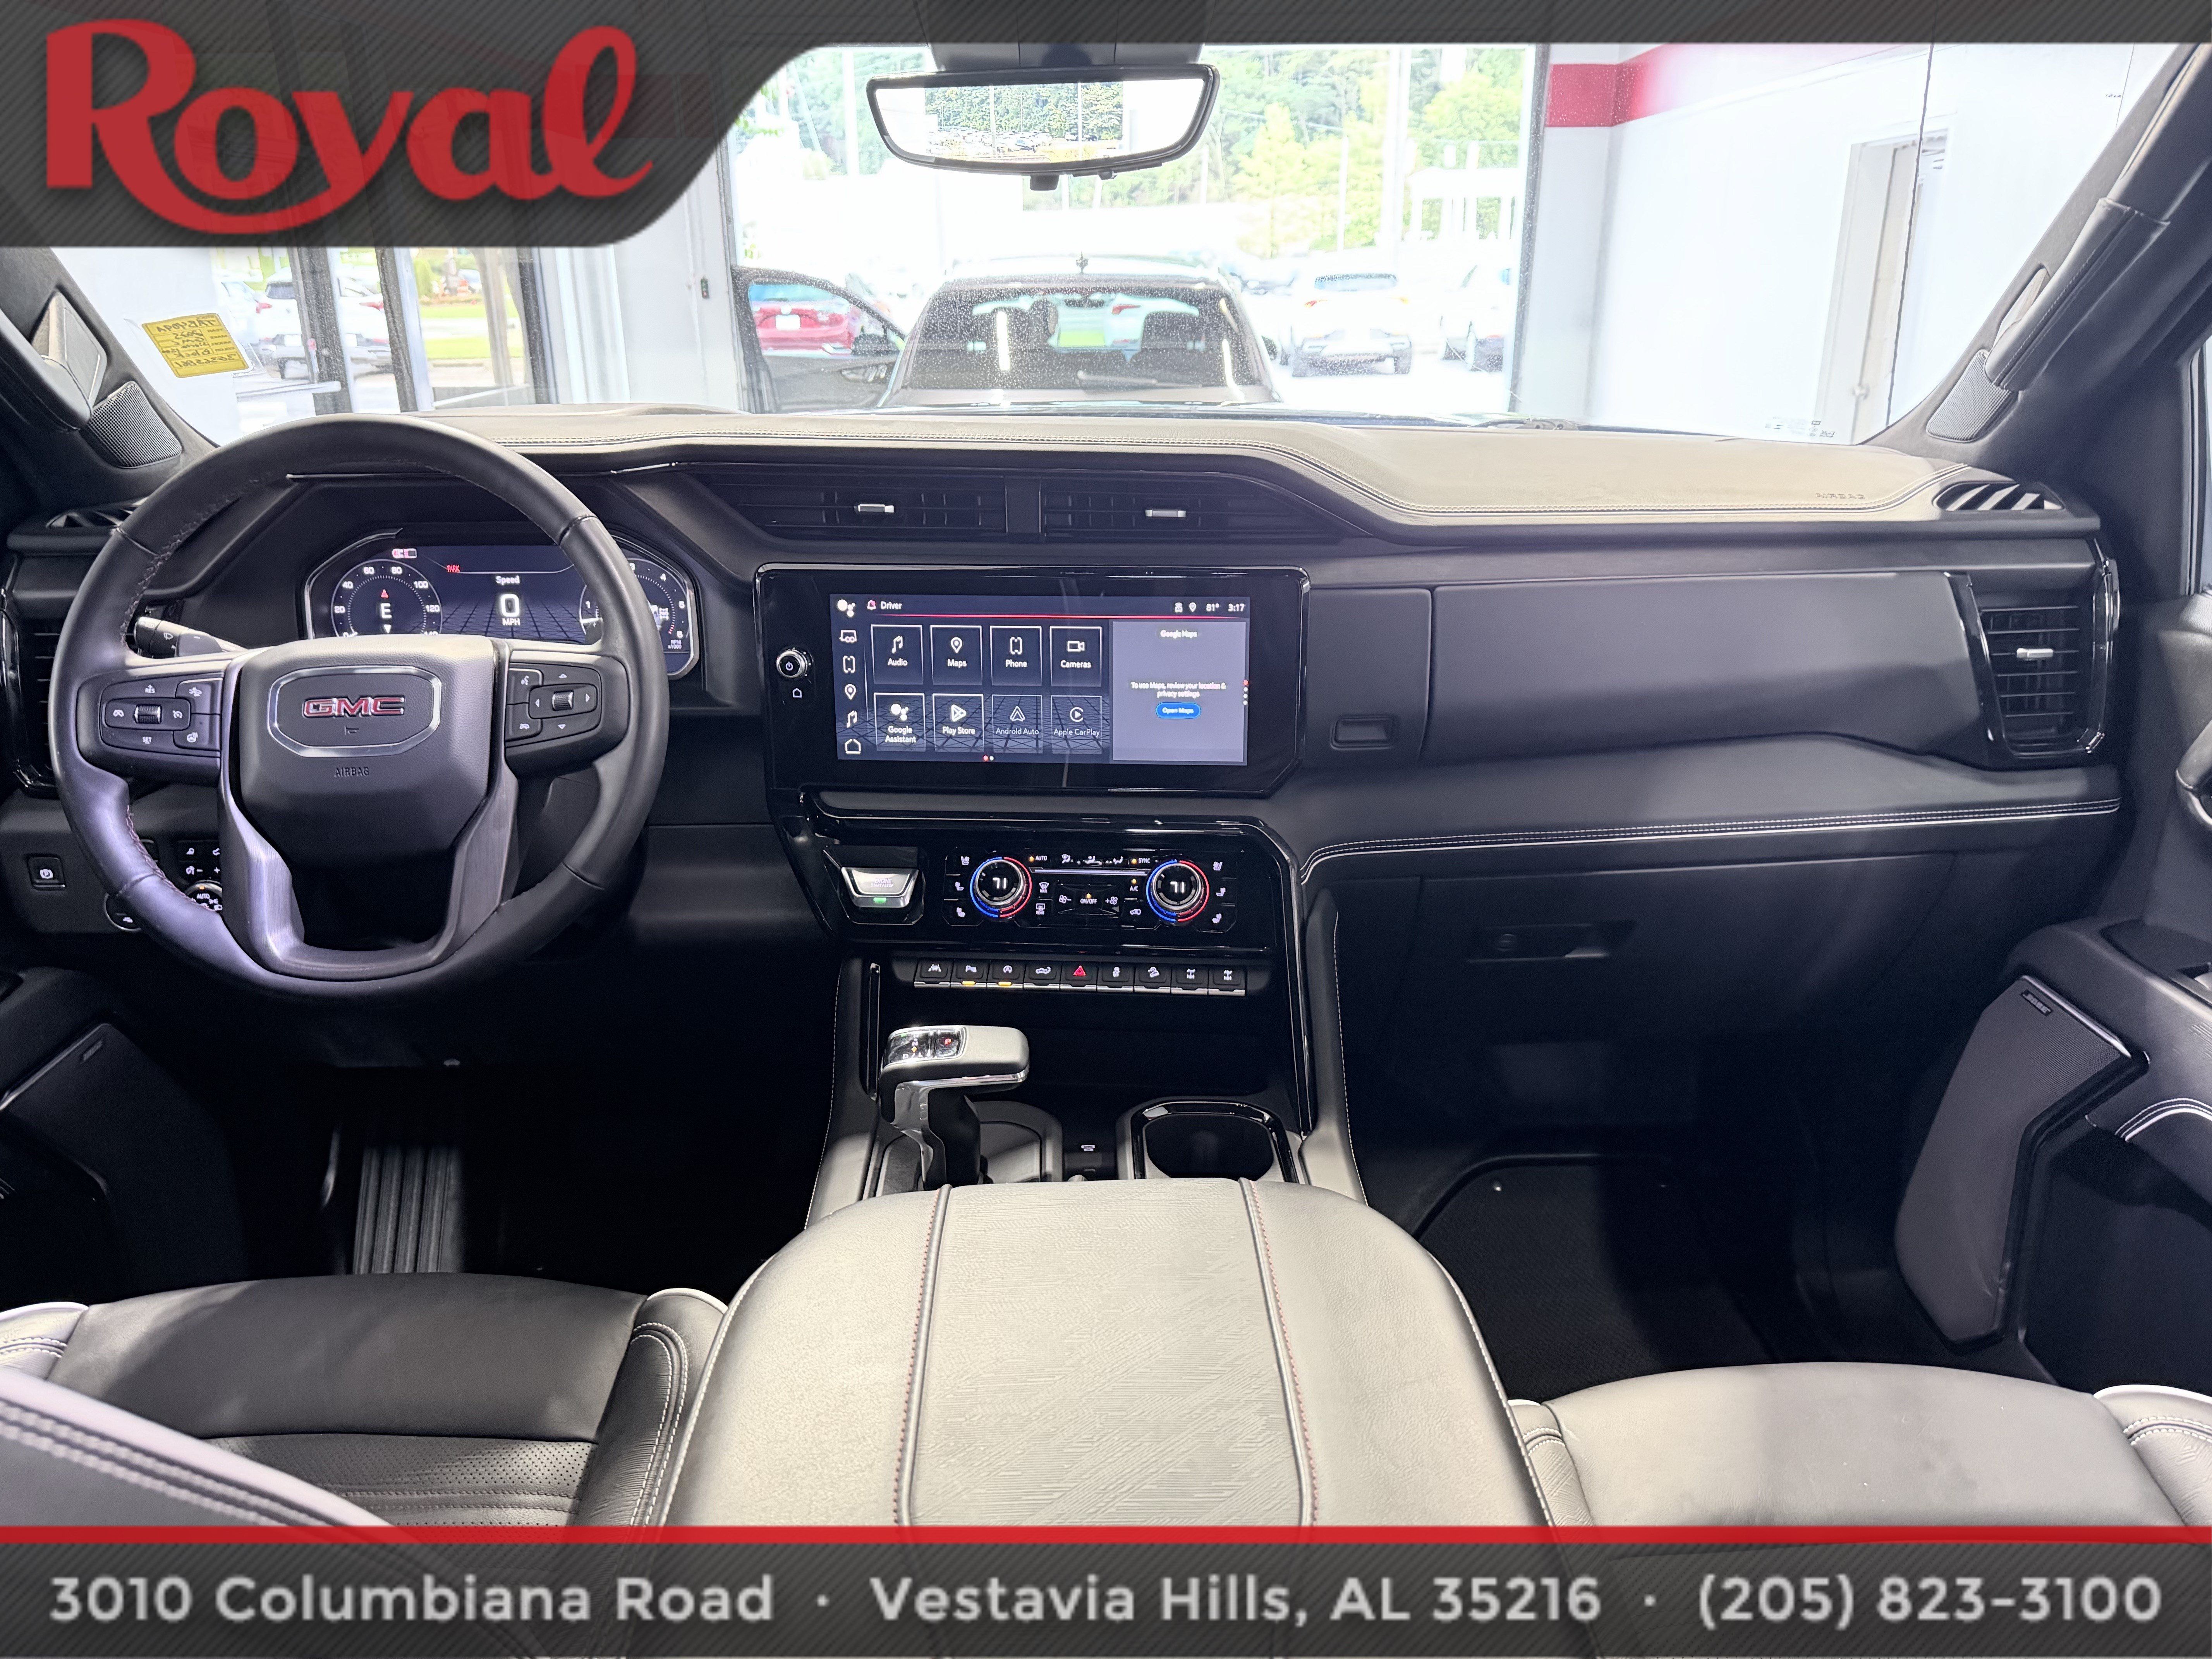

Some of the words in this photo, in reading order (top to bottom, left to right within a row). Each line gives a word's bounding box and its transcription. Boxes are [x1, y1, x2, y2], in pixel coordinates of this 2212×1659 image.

[495, 575, 520, 585] Speed
[500, 594, 520, 617] 0
[679, 601, 685, 609] 5
[880, 601, 902, 610] Driver
[1228, 603, 1245, 611] 3:17
[381, 603, 392, 618] E
[502, 618, 520, 626] MPH
[1160, 629, 1182, 639] Google
[1182, 630, 1198, 638] Maps
[887, 658, 908, 666] Audio
[947, 658, 967, 668] Maps
[1005, 659, 1027, 668] Phone
[1060, 660, 1092, 668] Cameras
[1177, 690, 1200, 699] settings
[304, 697, 405, 717] GMC
[888, 725, 913, 735] Google
[942, 726, 957, 736] Play
[1053, 728, 1073, 736] Apple
[1074, 728, 1100, 737] CarPlay
[334, 767, 369, 777] AIRBAG
[993, 877, 1007, 889] 71
[1170, 881, 1185, 893] 71
